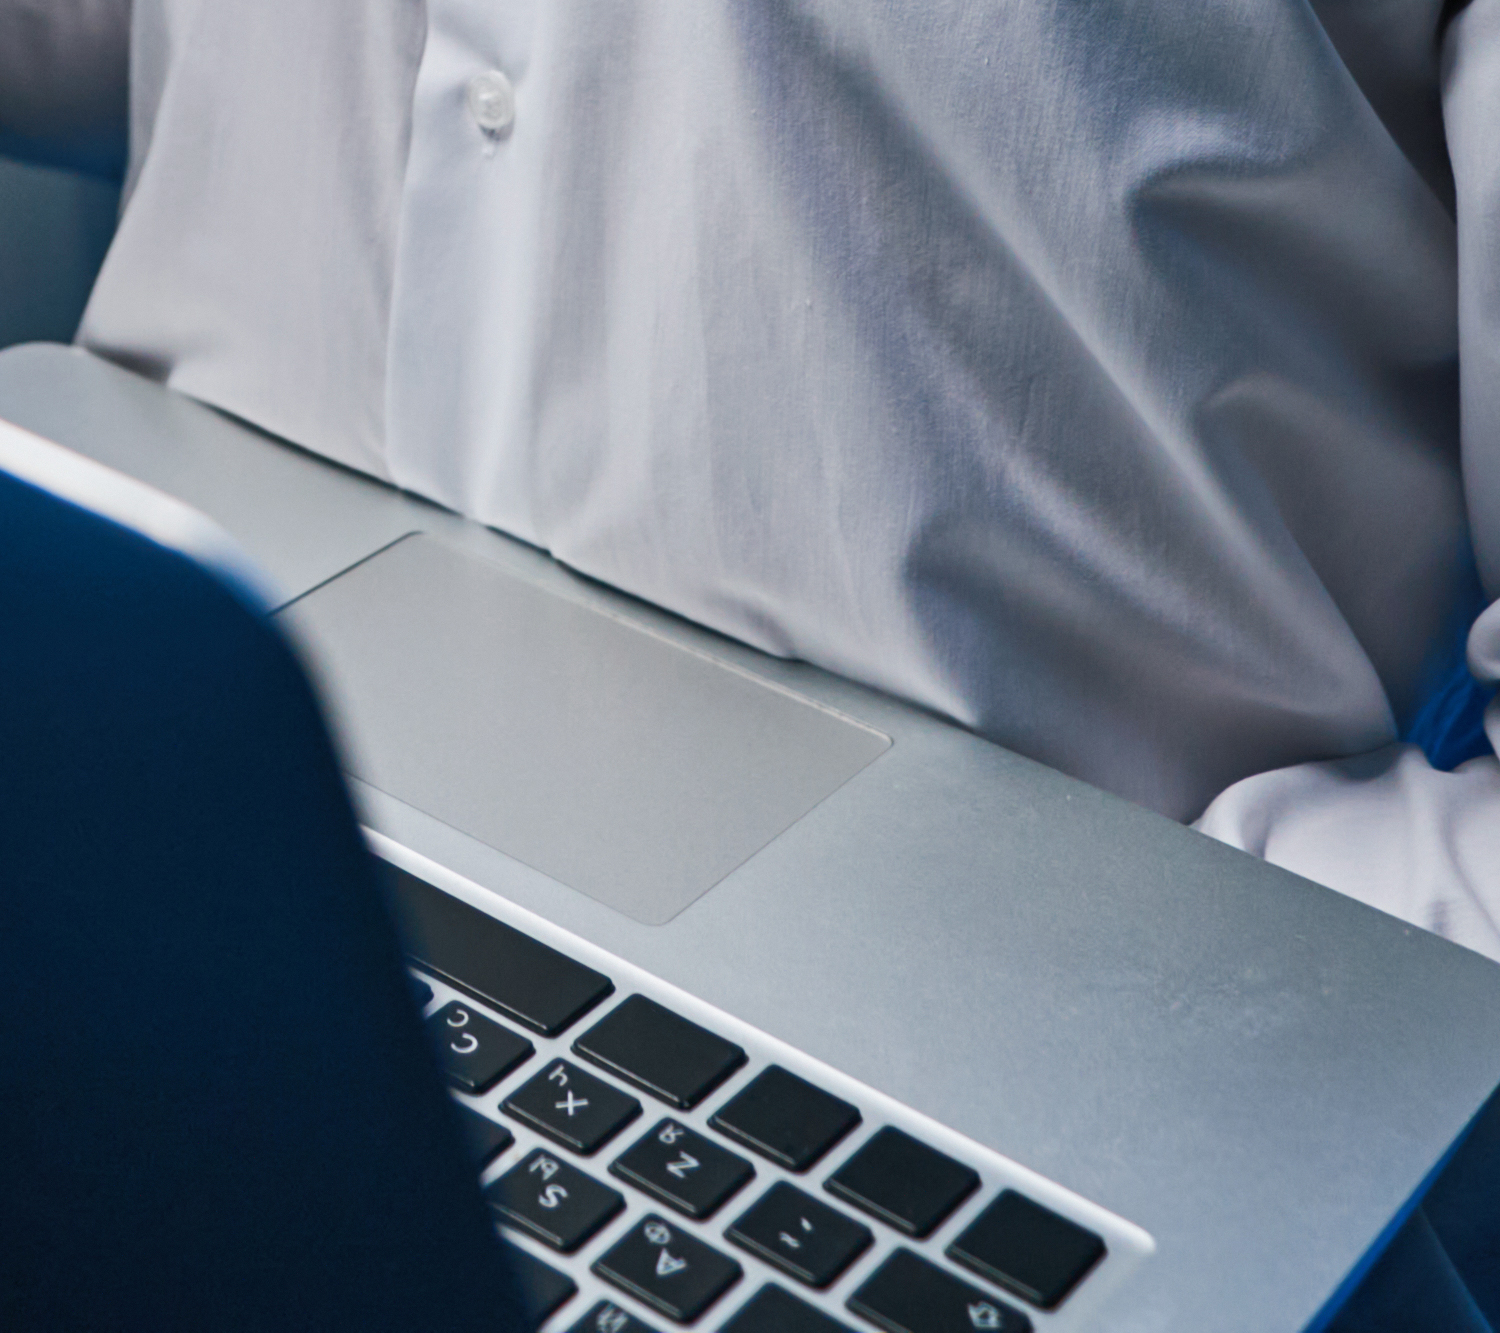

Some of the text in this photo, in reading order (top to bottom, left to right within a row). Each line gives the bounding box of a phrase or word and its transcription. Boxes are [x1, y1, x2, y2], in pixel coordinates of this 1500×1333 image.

[555, 1089, 589, 1116] X
[665, 1150, 701, 1179] Z
[537, 1183, 569, 1208] S
[655, 1247, 687, 1277] A
